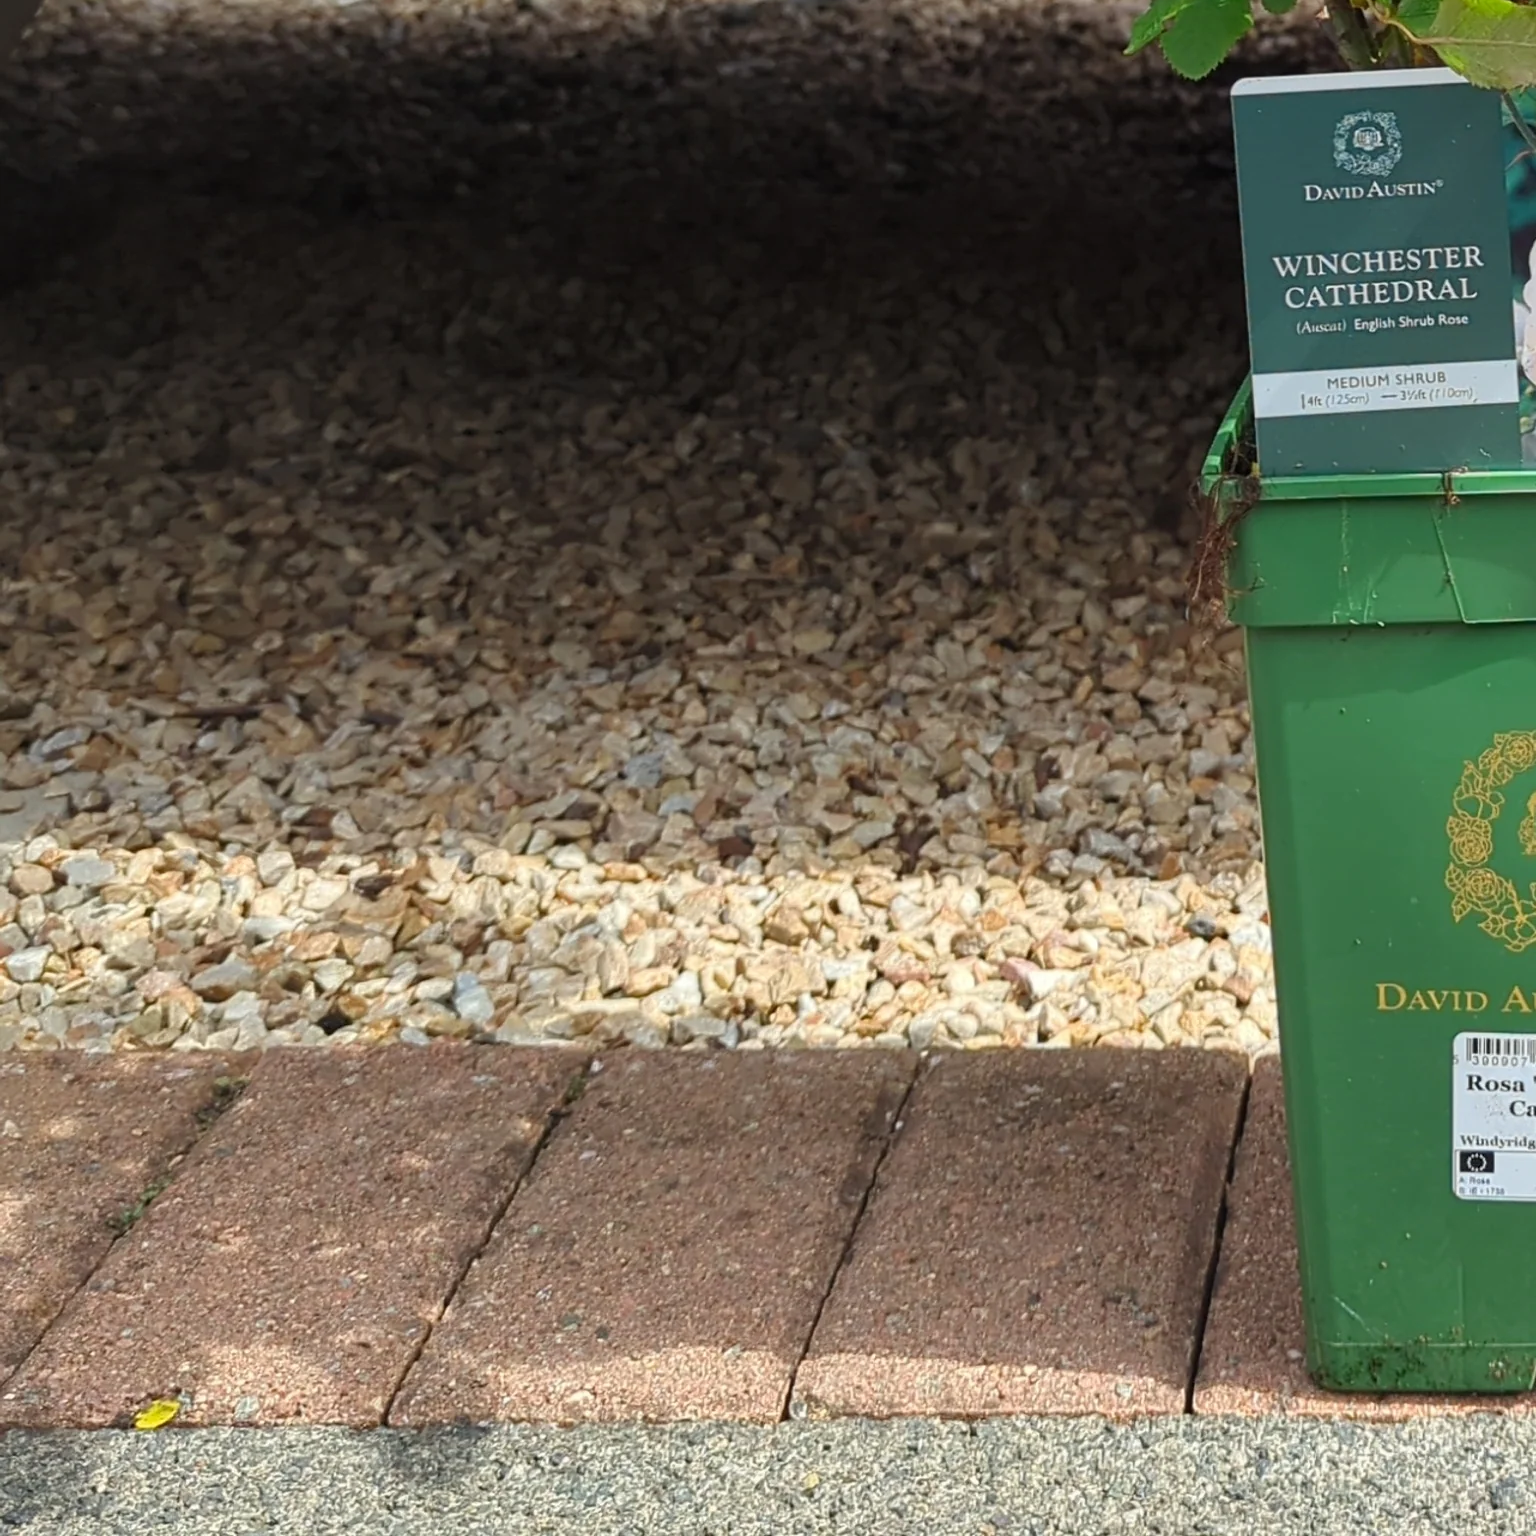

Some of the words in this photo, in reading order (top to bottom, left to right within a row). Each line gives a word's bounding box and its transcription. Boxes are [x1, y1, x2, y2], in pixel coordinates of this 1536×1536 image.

[1272, 245, 1485, 278] WINCHESTER
[1284, 277, 1478, 309] CATHEDRAL
[1296, 319, 1347, 335] (Auscat)
[1353, 316, 1396, 333] English
[1399, 315, 1435, 328] Shrub
[1438, 313, 1469, 326] Rose
[1327, 374, 1390, 390] MEDIUM
[1395, 371, 1447, 386] SHRUB
[1375, 983, 1489, 1012] DAVID
[1466, 1074, 1525, 1092] Rosa
